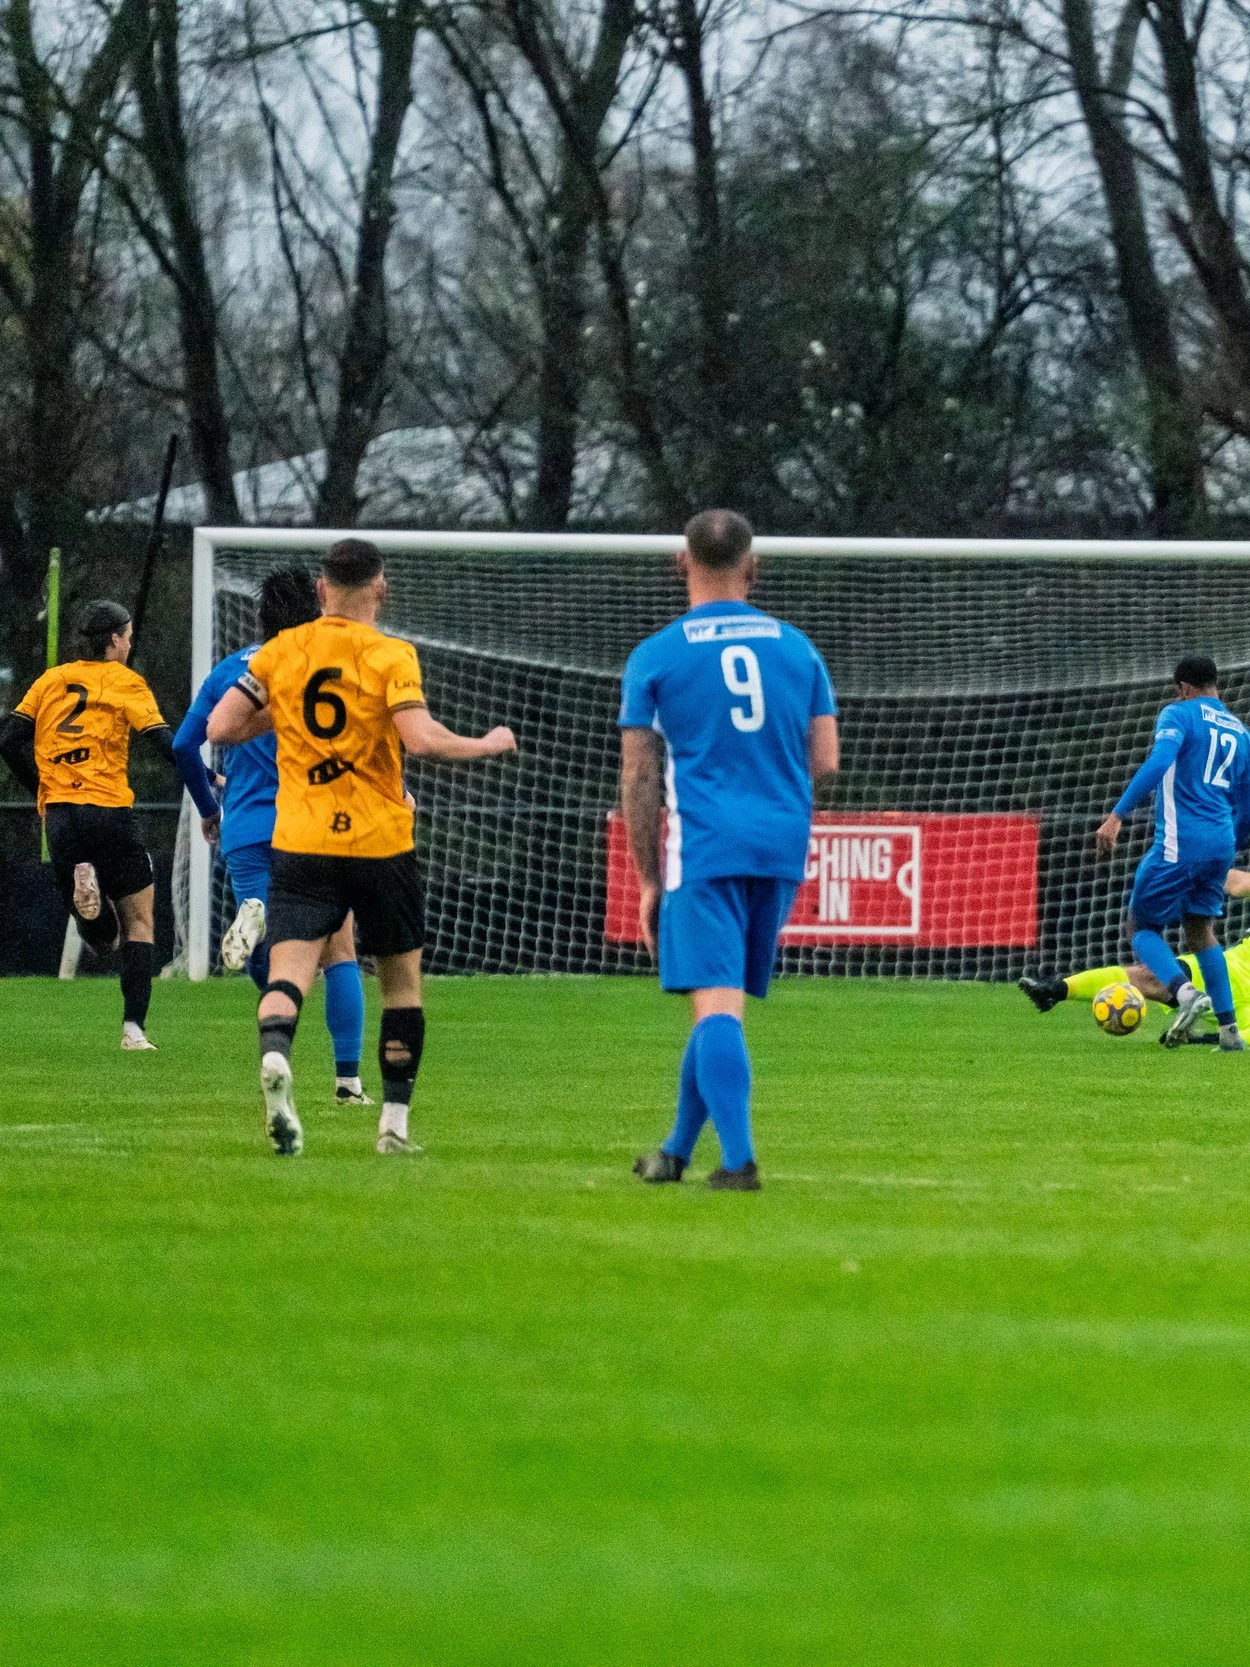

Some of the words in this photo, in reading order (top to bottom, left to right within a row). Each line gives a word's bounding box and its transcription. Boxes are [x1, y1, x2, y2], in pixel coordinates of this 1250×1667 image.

[56, 683, 88, 733] 2
[303, 666, 347, 739] 6
[720, 644, 766, 733] 9
[1203, 727, 1237, 788] 12
[818, 880, 849, 922] IN
